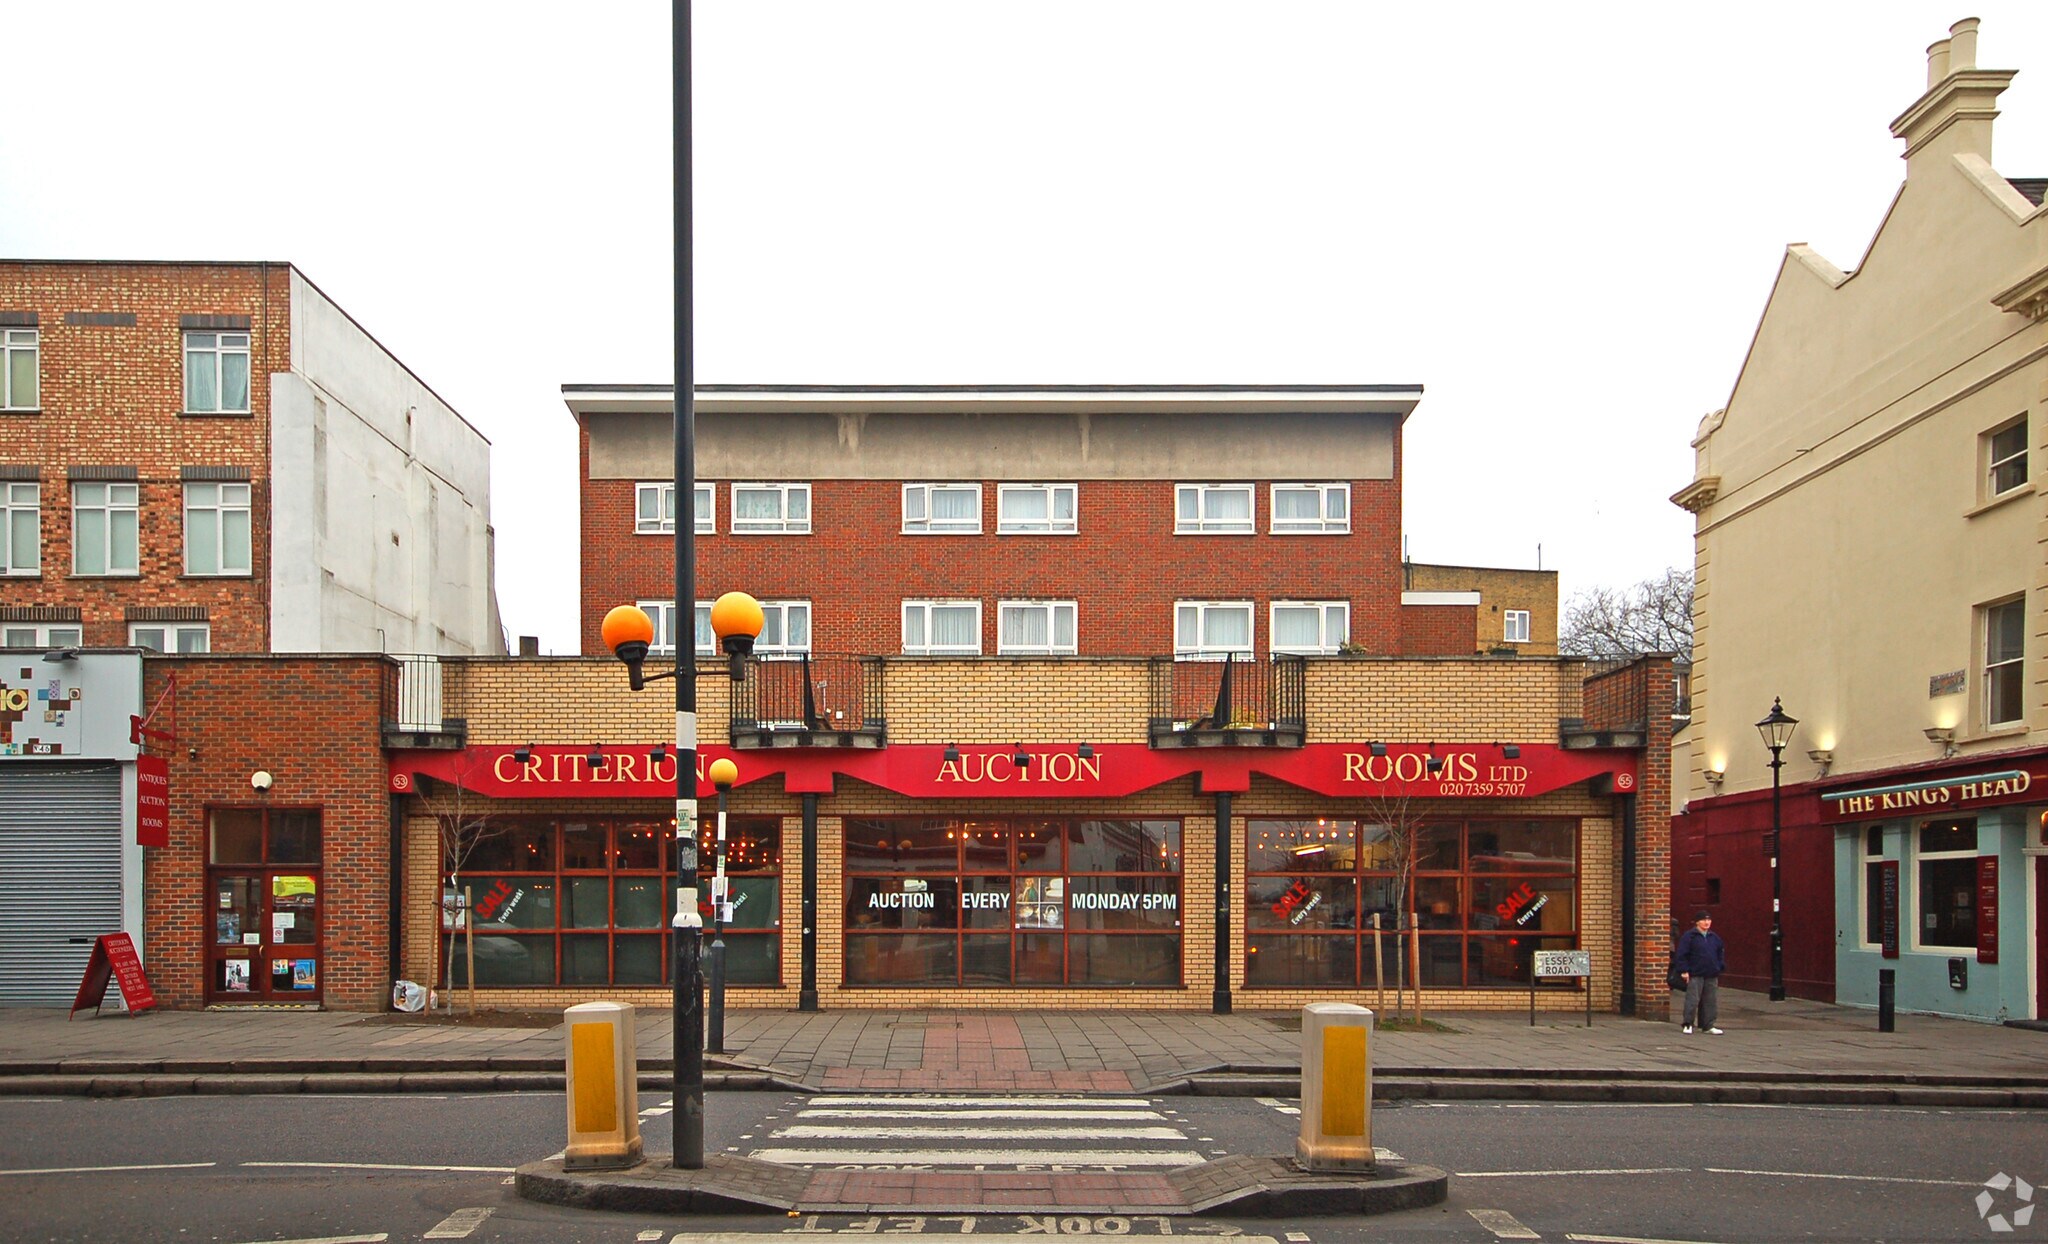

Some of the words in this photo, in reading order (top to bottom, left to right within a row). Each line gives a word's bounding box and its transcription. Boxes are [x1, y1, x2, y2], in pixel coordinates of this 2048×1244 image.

[934, 753, 1103, 782] AUCTION
[1342, 752, 1478, 783] ROOMS
[139, 773, 167, 785] ANTIQUES
[1440, 783, 1464, 796] 020
[1465, 783, 1494, 796] 7359
[1496, 783, 1526, 796] 5707
[1882, 786, 1951, 810] KINGS
[1961, 769, 2031, 800] HEAD
[139, 795, 165, 806] AUCTION
[142, 817, 163, 828] ROOMS
[475, 879, 513, 919] SALE
[498, 906, 514, 924] Every
[509, 888, 525, 908] week!
[868, 892, 935, 909] AUCTION
[961, 892, 1011, 909] EVERY
[1072, 893, 1139, 910] MONDAY
[1142, 893, 1177, 910] 5PM
[1271, 880, 1311, 920] SALE
[1496, 882, 1537, 920] SALE
[1291, 909, 1308, 926] Every
[1516, 910, 1535, 926] Every
[1531, 894, 1550, 912] week!
[1545, 956, 1575, 966] ESSEX
[1545, 966, 1571, 975] ROAD
[783, 1215, 977, 1233] LEFT
[1017, 1216, 1173, 1235] LOOK
